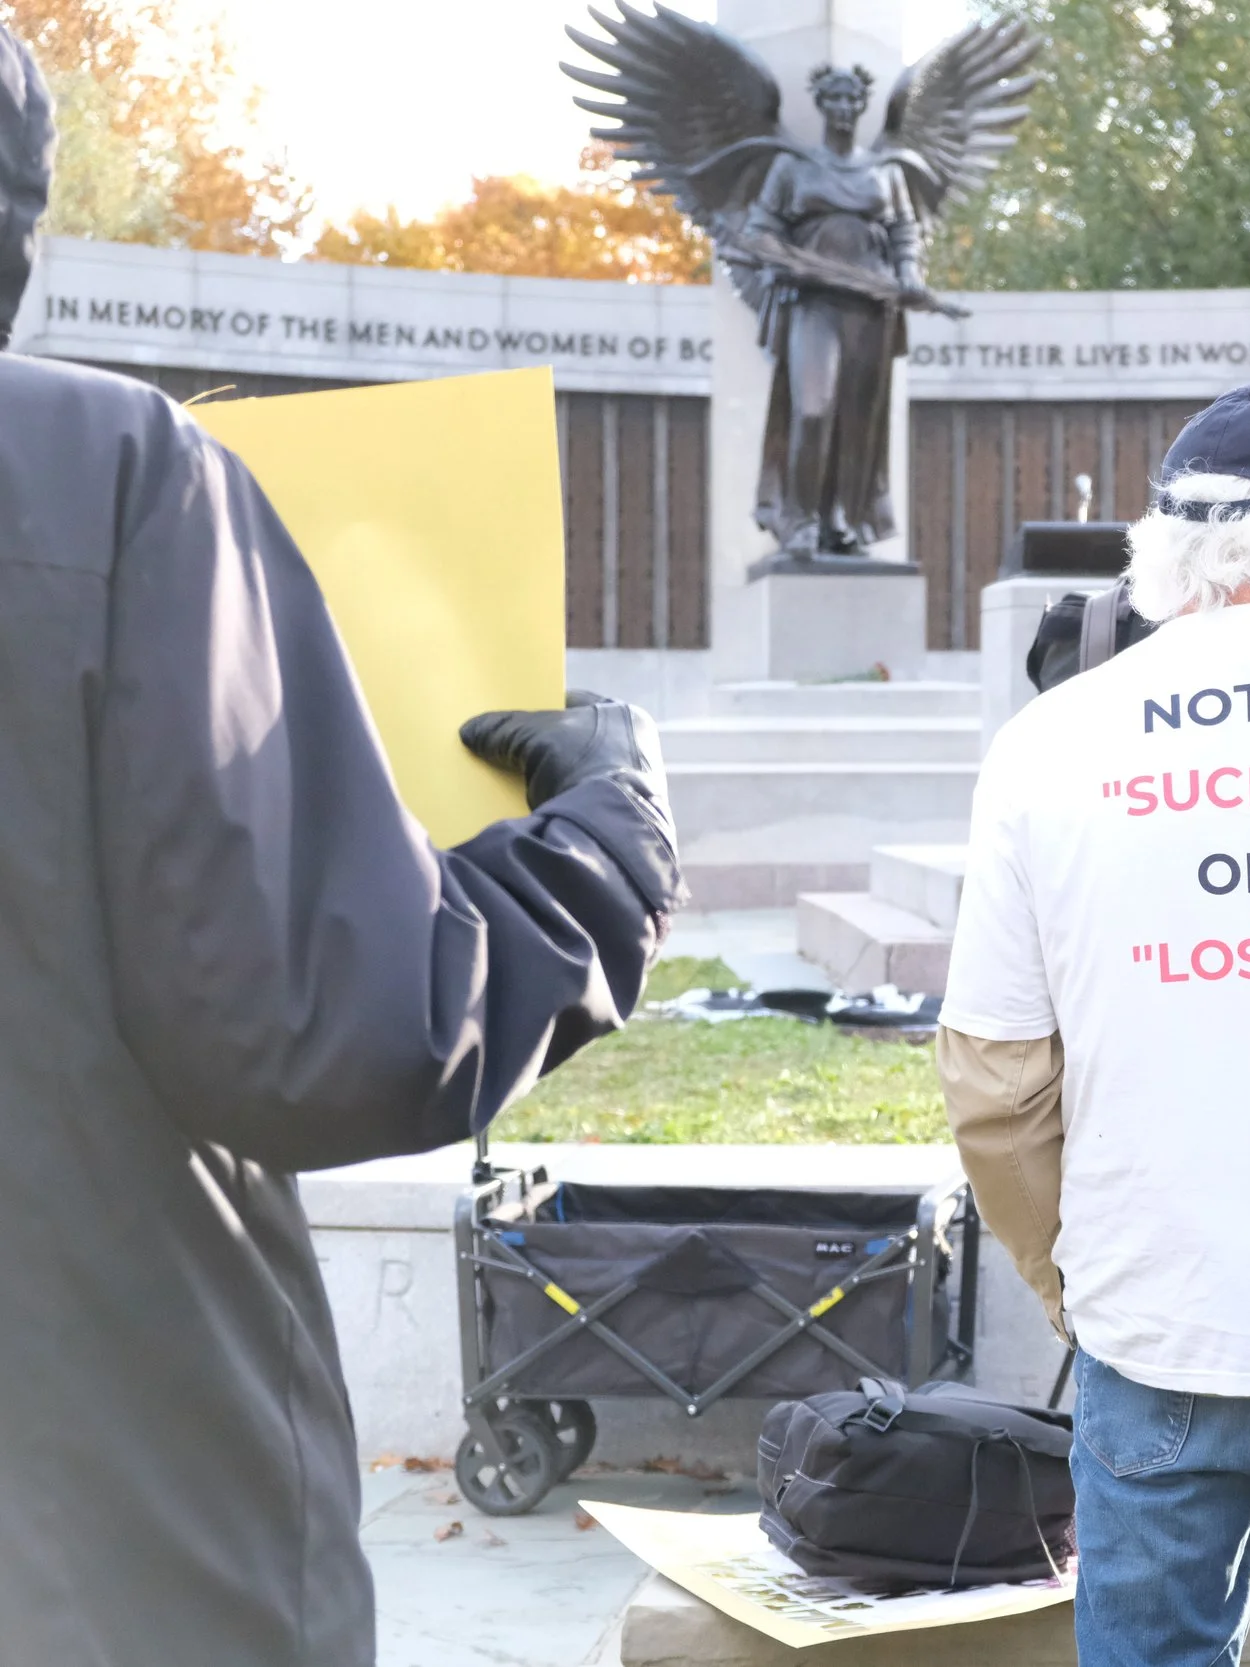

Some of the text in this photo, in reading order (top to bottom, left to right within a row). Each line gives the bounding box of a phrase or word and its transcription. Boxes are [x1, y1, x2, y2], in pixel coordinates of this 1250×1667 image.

[45, 297, 78, 321] IN
[88, 299, 225, 334] MEMORY
[230, 312, 271, 336] OF
[280, 315, 338, 343] THE
[349, 321, 416, 348] MEN
[422, 327, 490, 351] AND
[495, 330, 617, 356] WOMEN
[626, 336, 669, 360] OF
[977, 345, 1065, 367] THEIR
[1075, 344, 1150, 367] LIVES
[1160, 343, 1190, 365] IN
